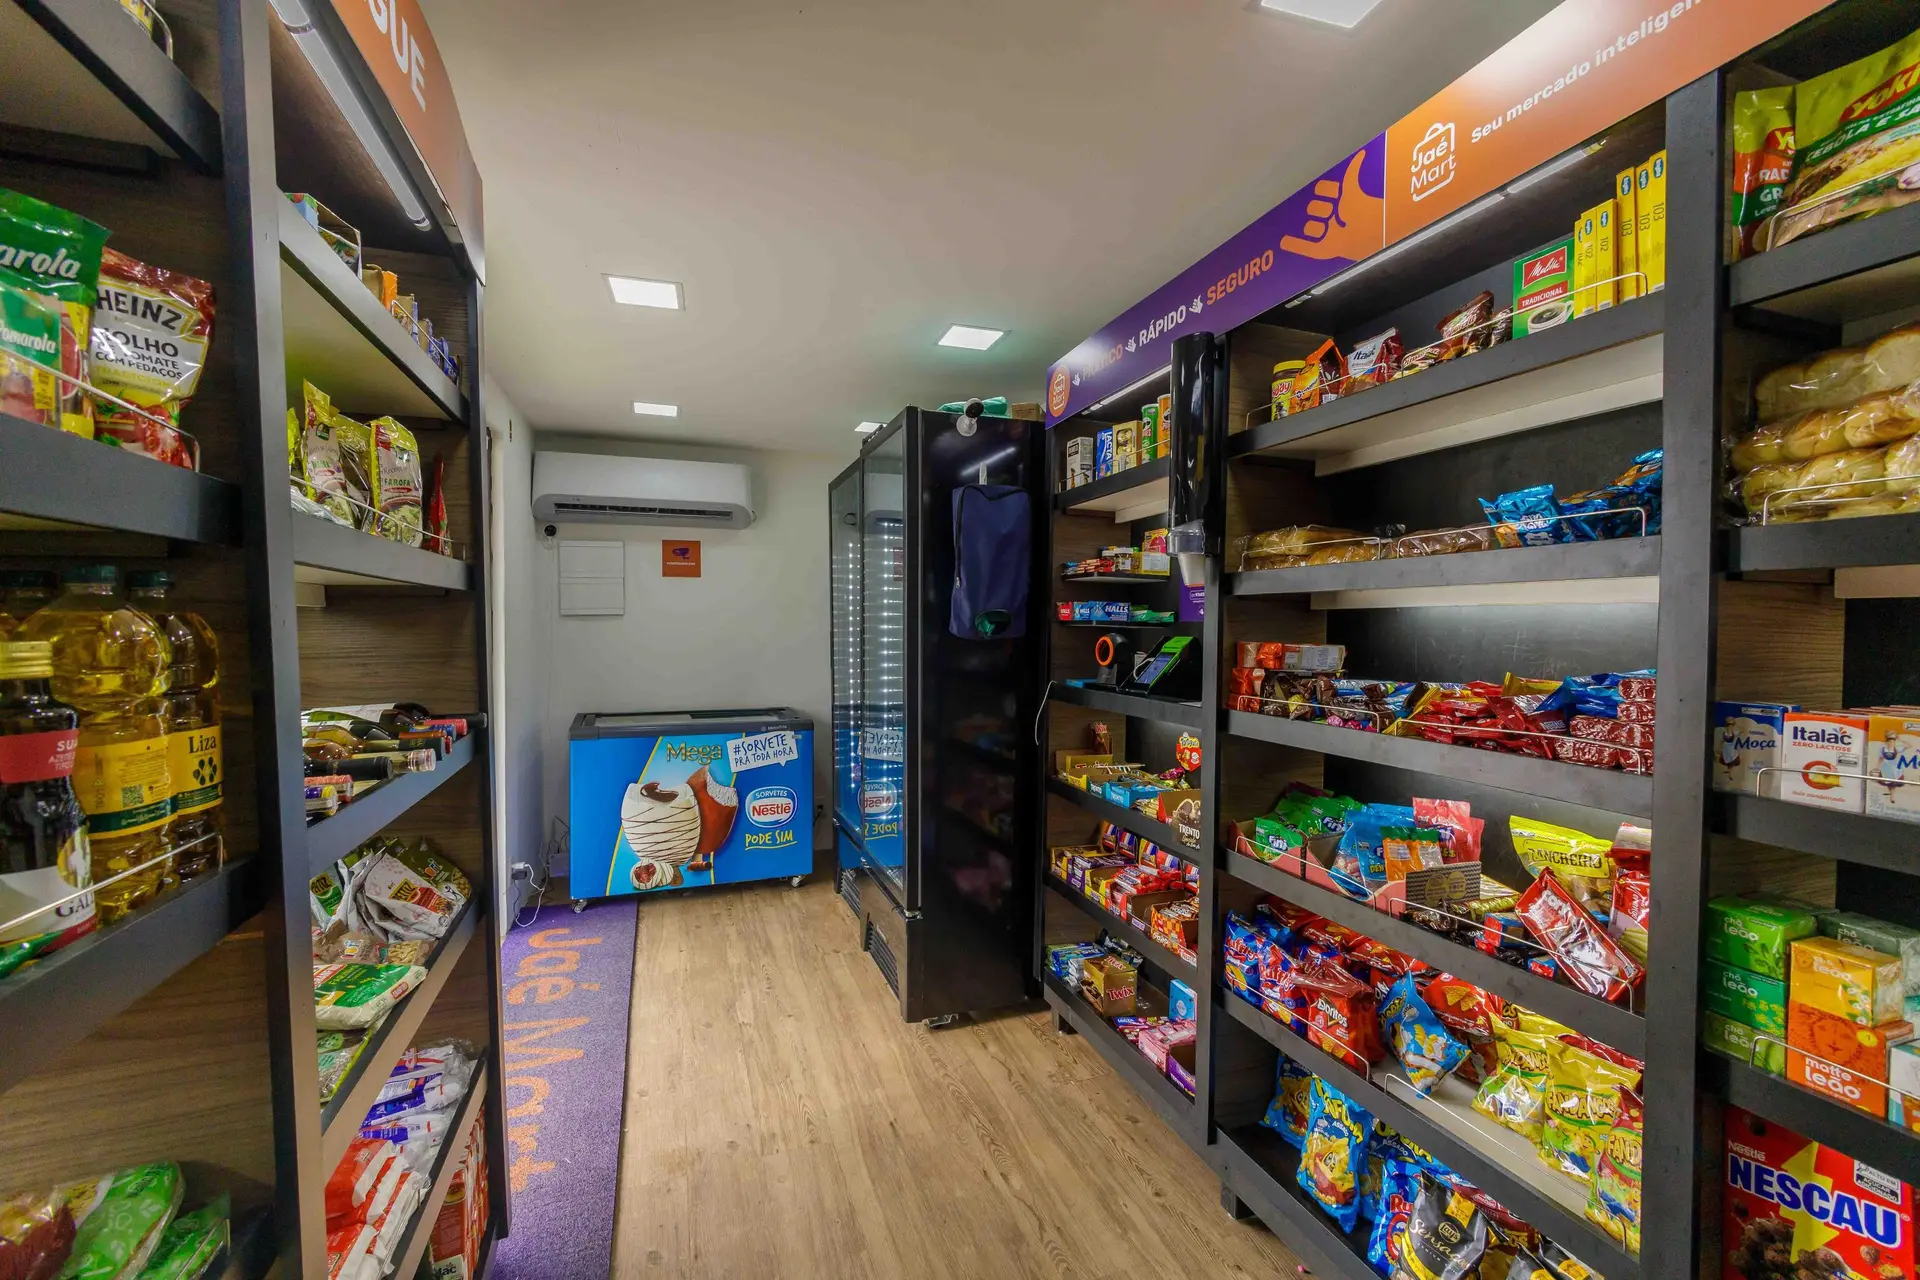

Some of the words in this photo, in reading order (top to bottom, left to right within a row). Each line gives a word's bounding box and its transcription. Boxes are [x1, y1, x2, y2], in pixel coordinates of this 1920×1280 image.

[1507, 61, 1590, 123] mercado
[1411, 137, 1449, 173] Jaé
[1410, 154, 1457, 194] Mart
[1640, 213, 1650, 231] 103
[1653, 202, 1664, 221] 103
[1622, 219, 1632, 237] 103
[1600, 237, 1608, 252] 102
[1206, 249, 1274, 306] SEGURO
[1521, 287, 1564, 308] TRADICIONAL
[96, 289, 183, 331] HEINZ
[1139, 304, 1187, 348] RÁPIDO
[95, 351, 124, 366] COM
[128, 361, 183, 380] PEDAÇOS
[1104, 432, 1113, 460] LACTA
[384, 478, 411, 487] FAROFA
[1105, 605, 1129, 613] HALLS
[188, 735, 217, 755] Liza
[733, 734, 788, 756] #SORVETE
[1734, 737, 1777, 751] Moça
[1792, 726, 1853, 746] Italac
[666, 742, 723, 765] Mega
[735, 757, 751, 767] PRA
[752, 751, 771, 763] TODA
[773, 747, 794, 759] HORA
[1792, 741, 1814, 749] ZERO
[1815, 742, 1852, 753] LACTOSE
[755, 789, 788, 799] SORVETES
[745, 832, 773, 847] PODE
[776, 829, 794, 843] SIM
[1178, 823, 1201, 839] TRENTO
[1269, 836, 1288, 850] Fini
[1724, 923, 1759, 942] leão
[507, 928, 602, 1005] Jaé
[1813, 960, 1853, 981] leão
[1259, 964, 1294, 992] Ruffles
[1723, 977, 1758, 997] leão
[1317, 998, 1349, 1028] Doritos
[1725, 1029, 1760, 1052] leão
[1805, 1057, 1852, 1082] matte
[1805, 1065, 1861, 1099] leão
[503, 1016, 590, 1193] Mart
[1332, 1120, 1349, 1137] ASSADO
[1383, 1139, 1409, 1157] ASSADO
[1728, 1152, 1901, 1248] NESCAU
